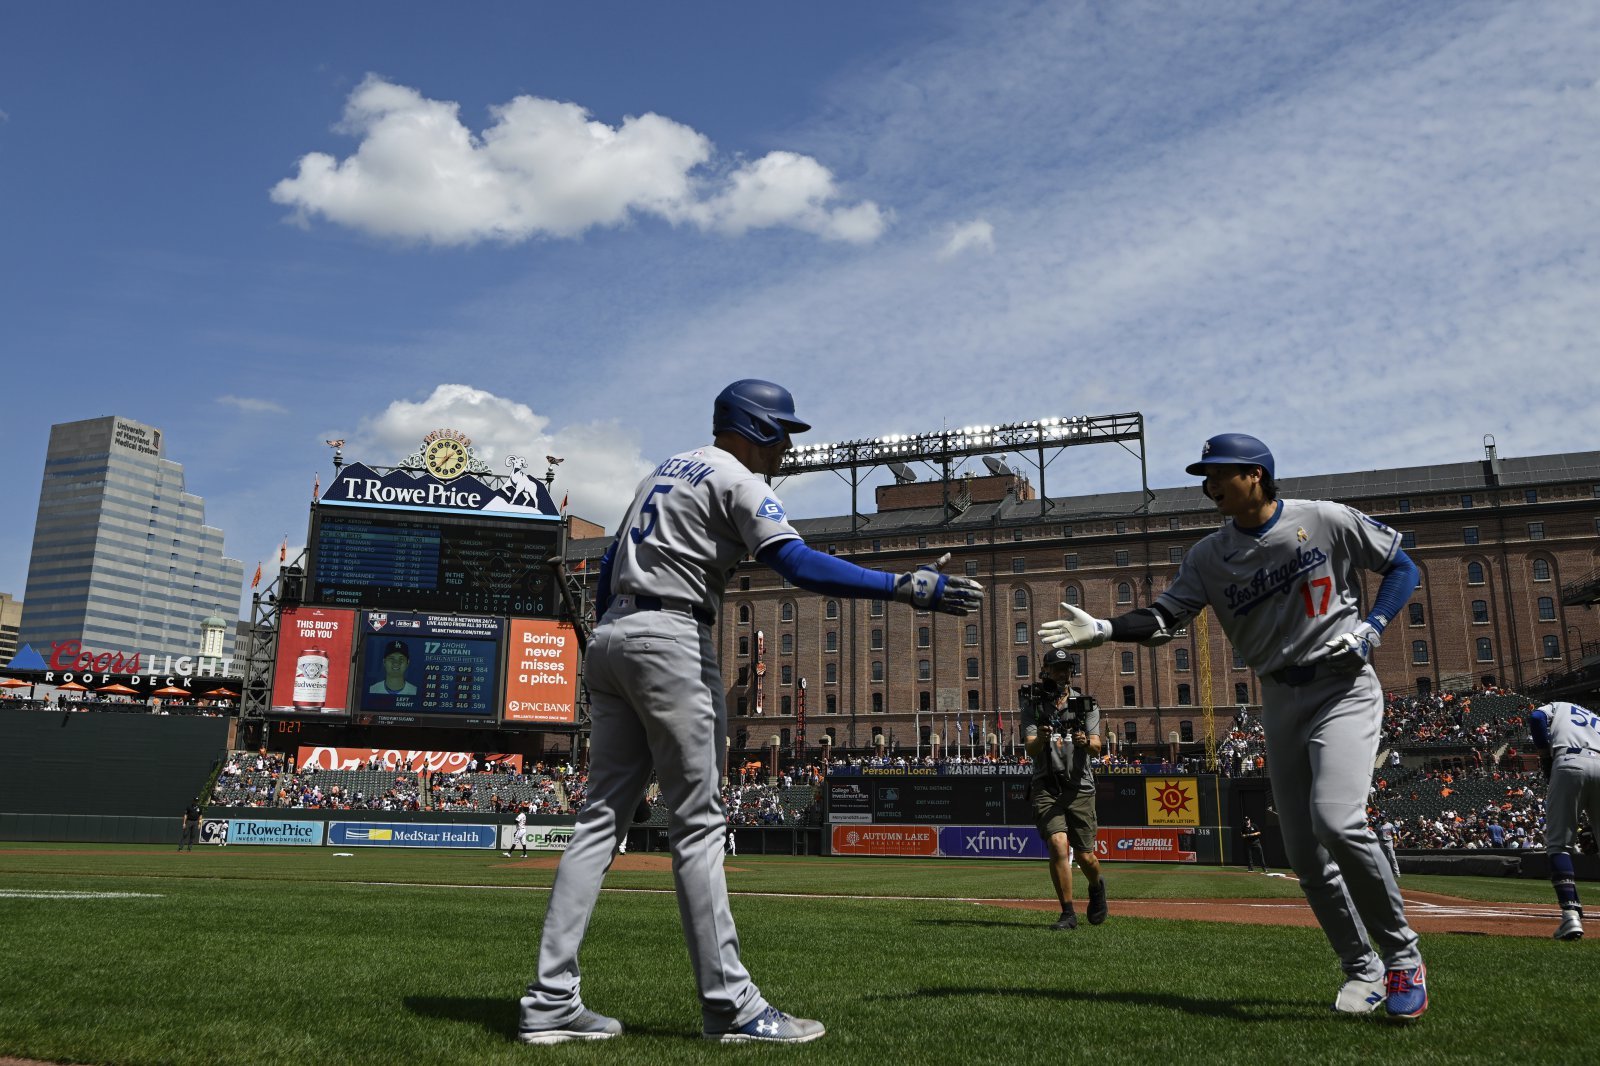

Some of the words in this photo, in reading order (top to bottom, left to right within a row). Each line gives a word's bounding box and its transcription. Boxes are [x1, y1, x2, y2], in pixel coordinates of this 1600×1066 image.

[117, 422, 146, 437] University
[124, 432, 150, 446] Maryland
[115, 438, 137, 450] Medical
[138, 444, 158, 456] System
[427, 483, 481, 508] Price
[630, 484, 674, 545] 5
[765, 503, 779, 514] G
[1224, 583, 1252, 610] Los
[1251, 546, 1328, 595] Angeles
[1300, 575, 1332, 618] 17
[526, 603, 532, 611] 0
[537, 604, 543, 612] 0
[296, 620, 314, 629] THIS
[315, 621, 338, 630] BUD'S
[300, 630, 316, 638] FOR
[318, 630, 332, 639] YOU
[523, 632, 565, 647] Boring
[424, 642, 440, 654] 17
[525, 647, 562, 658] never
[50, 639, 142, 674] Coors
[148, 654, 235, 678] LIGHT
[521, 658, 564, 671] misses
[45, 672, 111, 684] ROOF
[131, 676, 193, 688] DECK
[519, 674, 528, 682] a
[530, 672, 568, 686] pitch.
[521, 702, 542, 711] PNC
[544, 704, 571, 712] BANK
[862, 767, 905, 776] Personal
[945, 765, 997, 775] MARINER
[1108, 766, 1142, 774] Loans
[248, 822, 282, 836] Rowe
[282, 824, 312, 836] Price
[394, 831, 440, 842] MedStar
[442, 832, 479, 842] Health
[526, 834, 542, 842] CP
[862, 832, 902, 840] AUTUMN
[904, 833, 930, 841] LAKE
[966, 830, 1028, 854] xfinity
[1134, 838, 1173, 847] CARROLL
